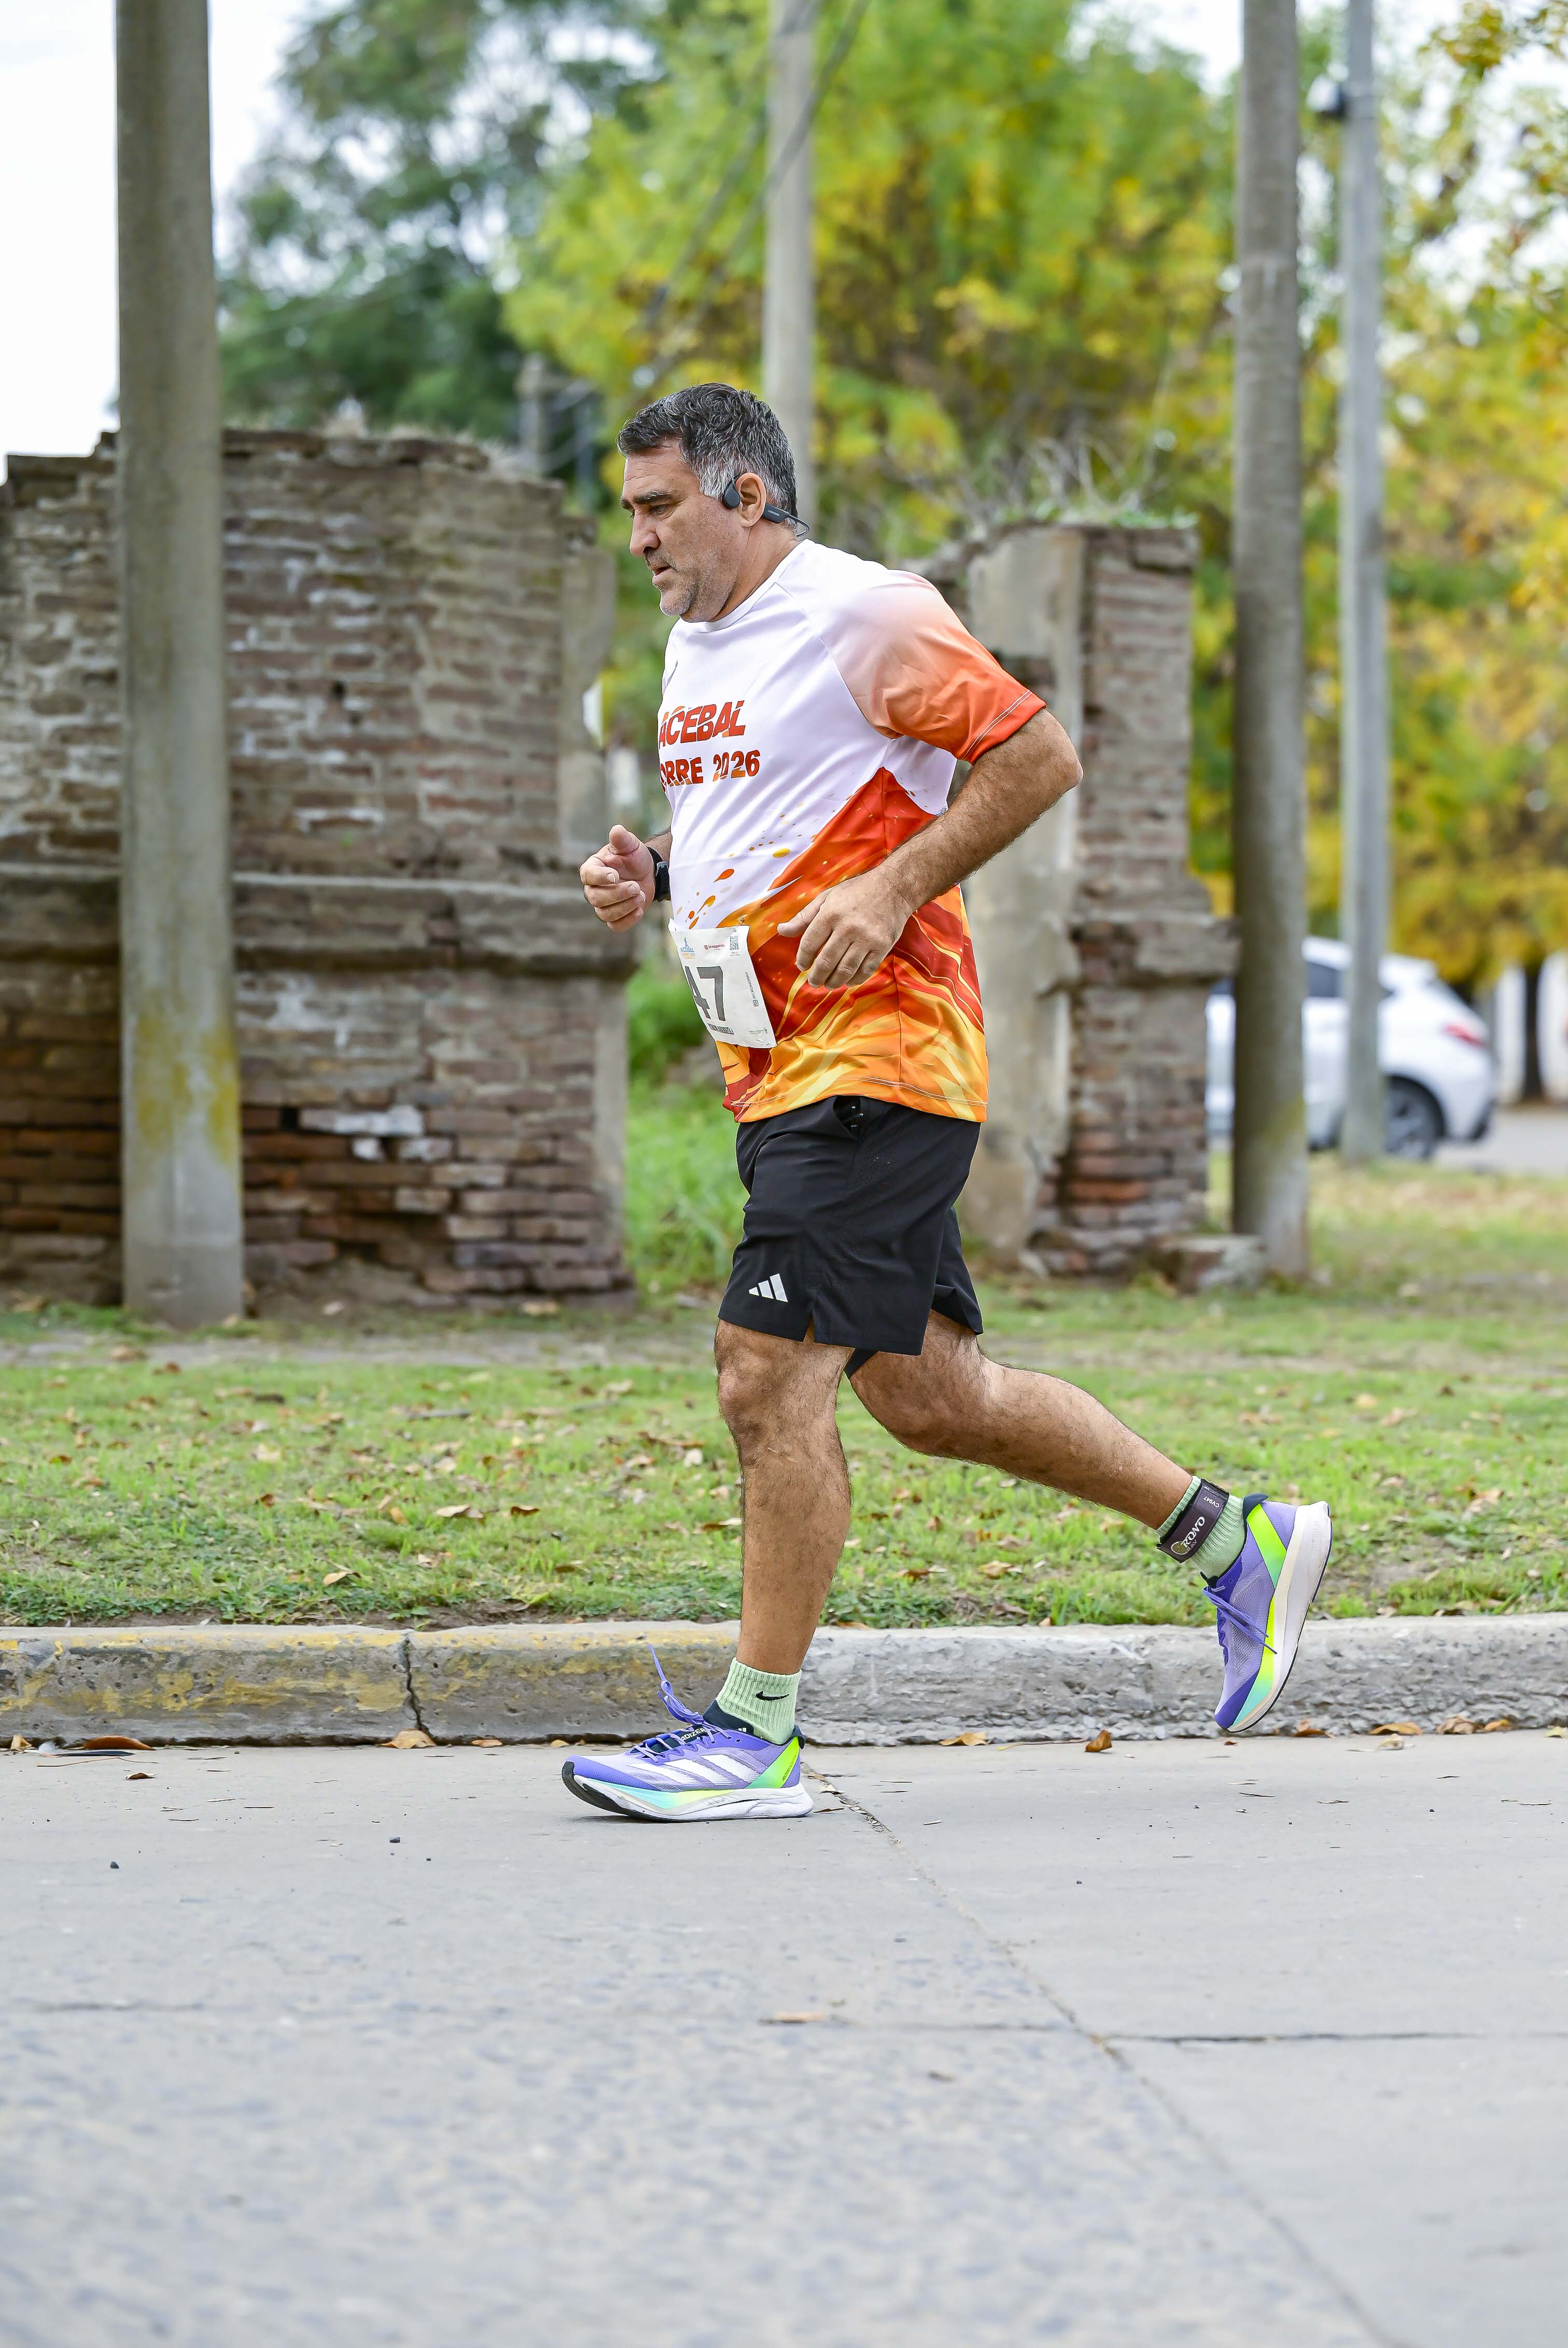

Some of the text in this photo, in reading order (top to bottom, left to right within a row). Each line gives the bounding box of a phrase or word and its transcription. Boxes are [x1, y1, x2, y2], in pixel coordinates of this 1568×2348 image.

[659, 700, 746, 749] ACEBAL
[660, 750, 760, 788] ORRE 2026
[684, 966, 725, 1021] 47
[1203, 1496, 1220, 1508] CV047
[681, 1728, 707, 1741] ADIZER
